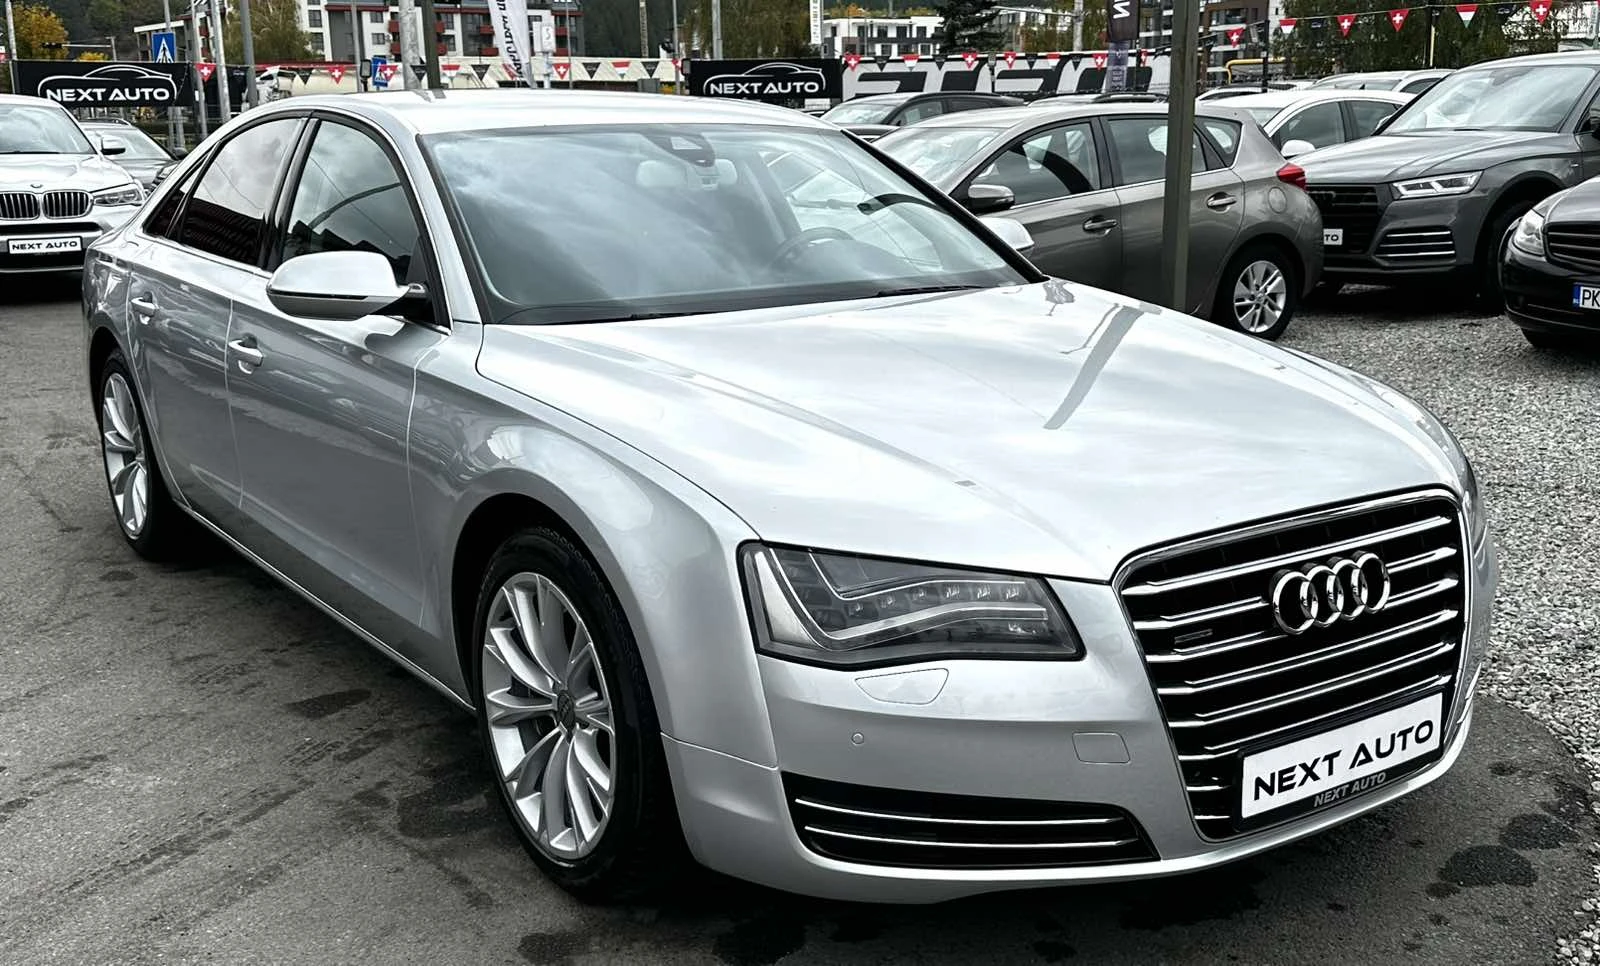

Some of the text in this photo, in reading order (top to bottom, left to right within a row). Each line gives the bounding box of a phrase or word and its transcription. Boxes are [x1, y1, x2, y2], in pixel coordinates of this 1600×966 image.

[46, 88, 170, 102] NEXT AUTO
[710, 81, 819, 95] NEXT AUTO
[12, 240, 78, 251] NEXT AUTO
[1254, 720, 1434, 801] NEXT AUTO
[1313, 771, 1387, 808] NEXT AUTO
